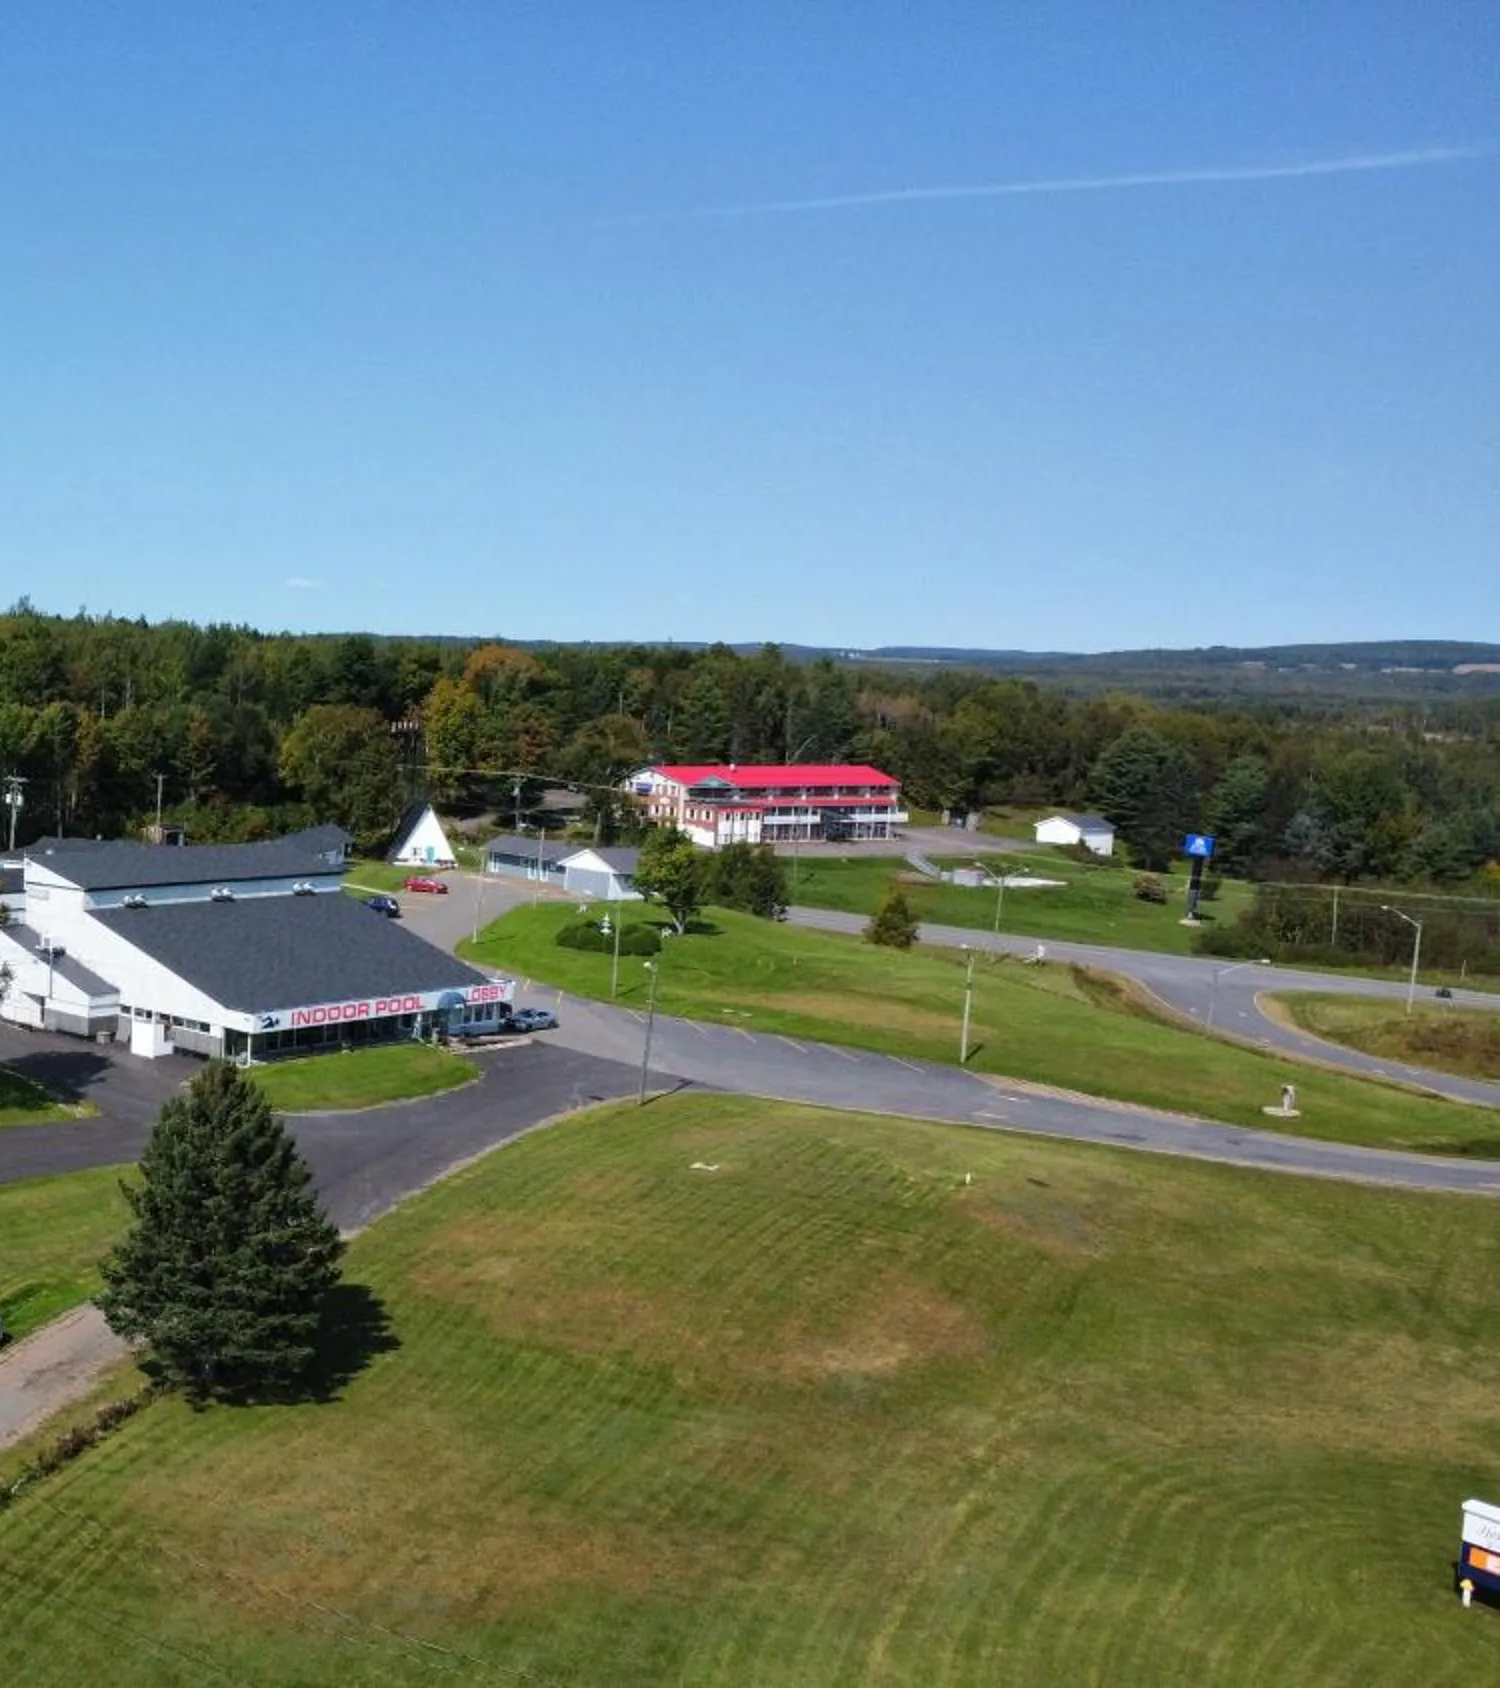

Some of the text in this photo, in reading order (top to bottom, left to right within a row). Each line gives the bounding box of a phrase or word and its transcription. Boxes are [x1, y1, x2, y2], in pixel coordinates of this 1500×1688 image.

[465, 985, 505, 1003] LOBBY
[291, 996, 426, 1025] INDOOR POOL
